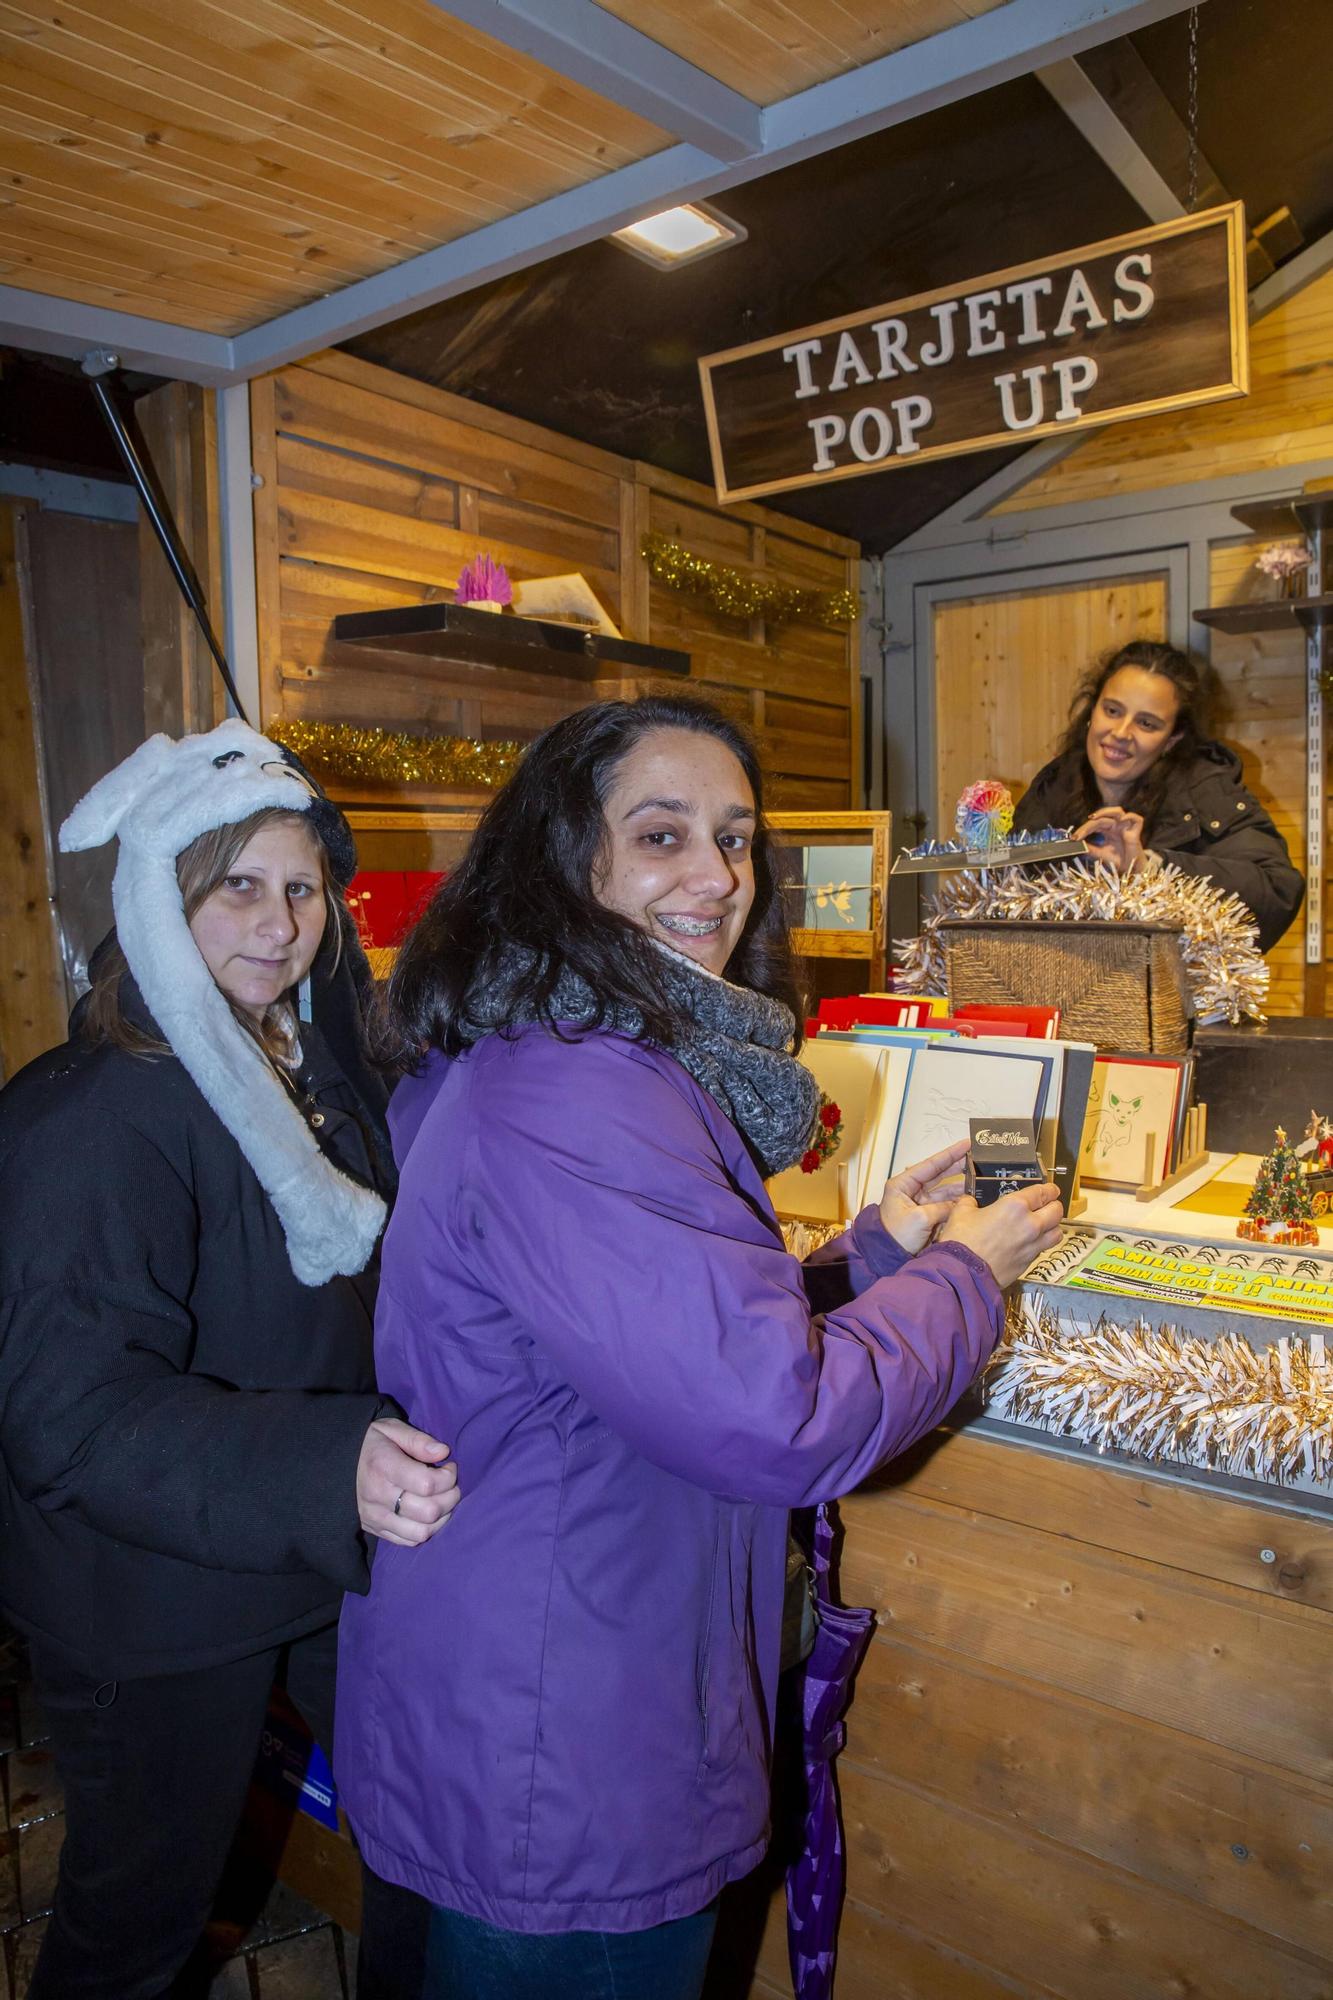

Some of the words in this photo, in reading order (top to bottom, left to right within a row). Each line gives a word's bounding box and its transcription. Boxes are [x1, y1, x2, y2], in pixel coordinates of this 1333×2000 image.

[783, 253, 1155, 399] TARJETAS
[807, 395, 933, 472] POP
[994, 355, 1098, 430] UP
[1096, 1262, 1152, 1281] CAMBIAN
[1152, 1274, 1175, 1284] DE
[1175, 1277, 1239, 1294] COLOR
[1105, 1247, 1215, 1278] ANILLOS
